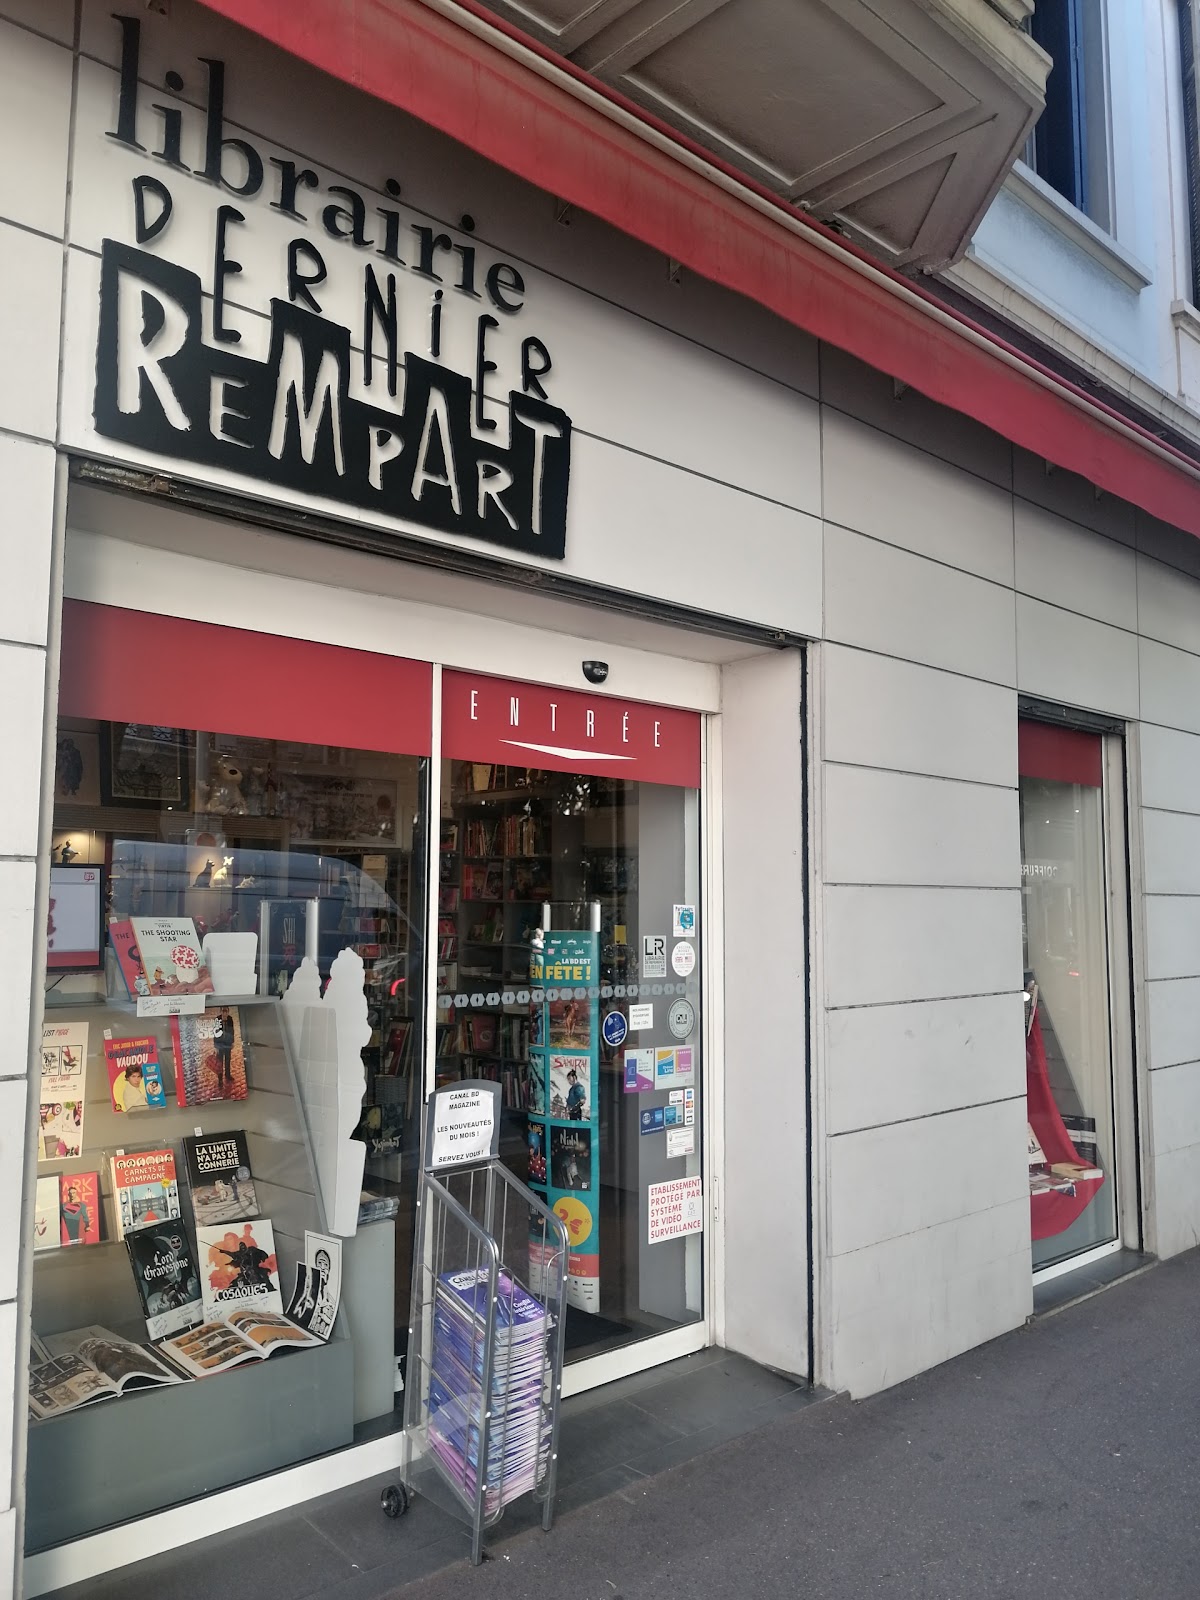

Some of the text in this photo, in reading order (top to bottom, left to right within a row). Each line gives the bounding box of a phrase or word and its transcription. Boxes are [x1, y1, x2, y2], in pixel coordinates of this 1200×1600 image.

[104, 14, 526, 314] librairie
[116, 265, 564, 536] REMPART
[470, 689, 661, 748] ENTRÉE
[115, 932, 130, 940] THE
[282, 917, 296, 944] SHI
[530, 961, 591, 981] EN FÊTE !
[198, 1027, 224, 1039] SEC
[116, 1053, 148, 1068] VAUDOU
[553, 1057, 587, 1073] SAMURAI
[449, 1092, 470, 1100] CANAL
[449, 1100, 480, 1110] MAGAZINE
[437, 1119, 492, 1133] LES NOUVEAUTÉS
[195, 1142, 238, 1156] LA LIMITE
[197, 1150, 239, 1163] N'A PAS DE
[198, 1157, 241, 1171] CONNERIE
[438, 1153, 464, 1163] SERVEZ
[124, 1165, 166, 1177] CARNETS DE
[124, 1172, 167, 1184] CAMPAGNE
[651, 1178, 701, 1196] ETABLISSEMENT
[651, 1189, 701, 1206] PROTÉGÉ PAR
[651, 1219, 659, 1228] DE
[661, 1212, 682, 1226] VIDÉO
[651, 1219, 701, 1239] SURVEILLANCE
[153, 1250, 176, 1266] Lord
[143, 1256, 189, 1281] Gravestone
[215, 1282, 269, 1302] COSAQUES
